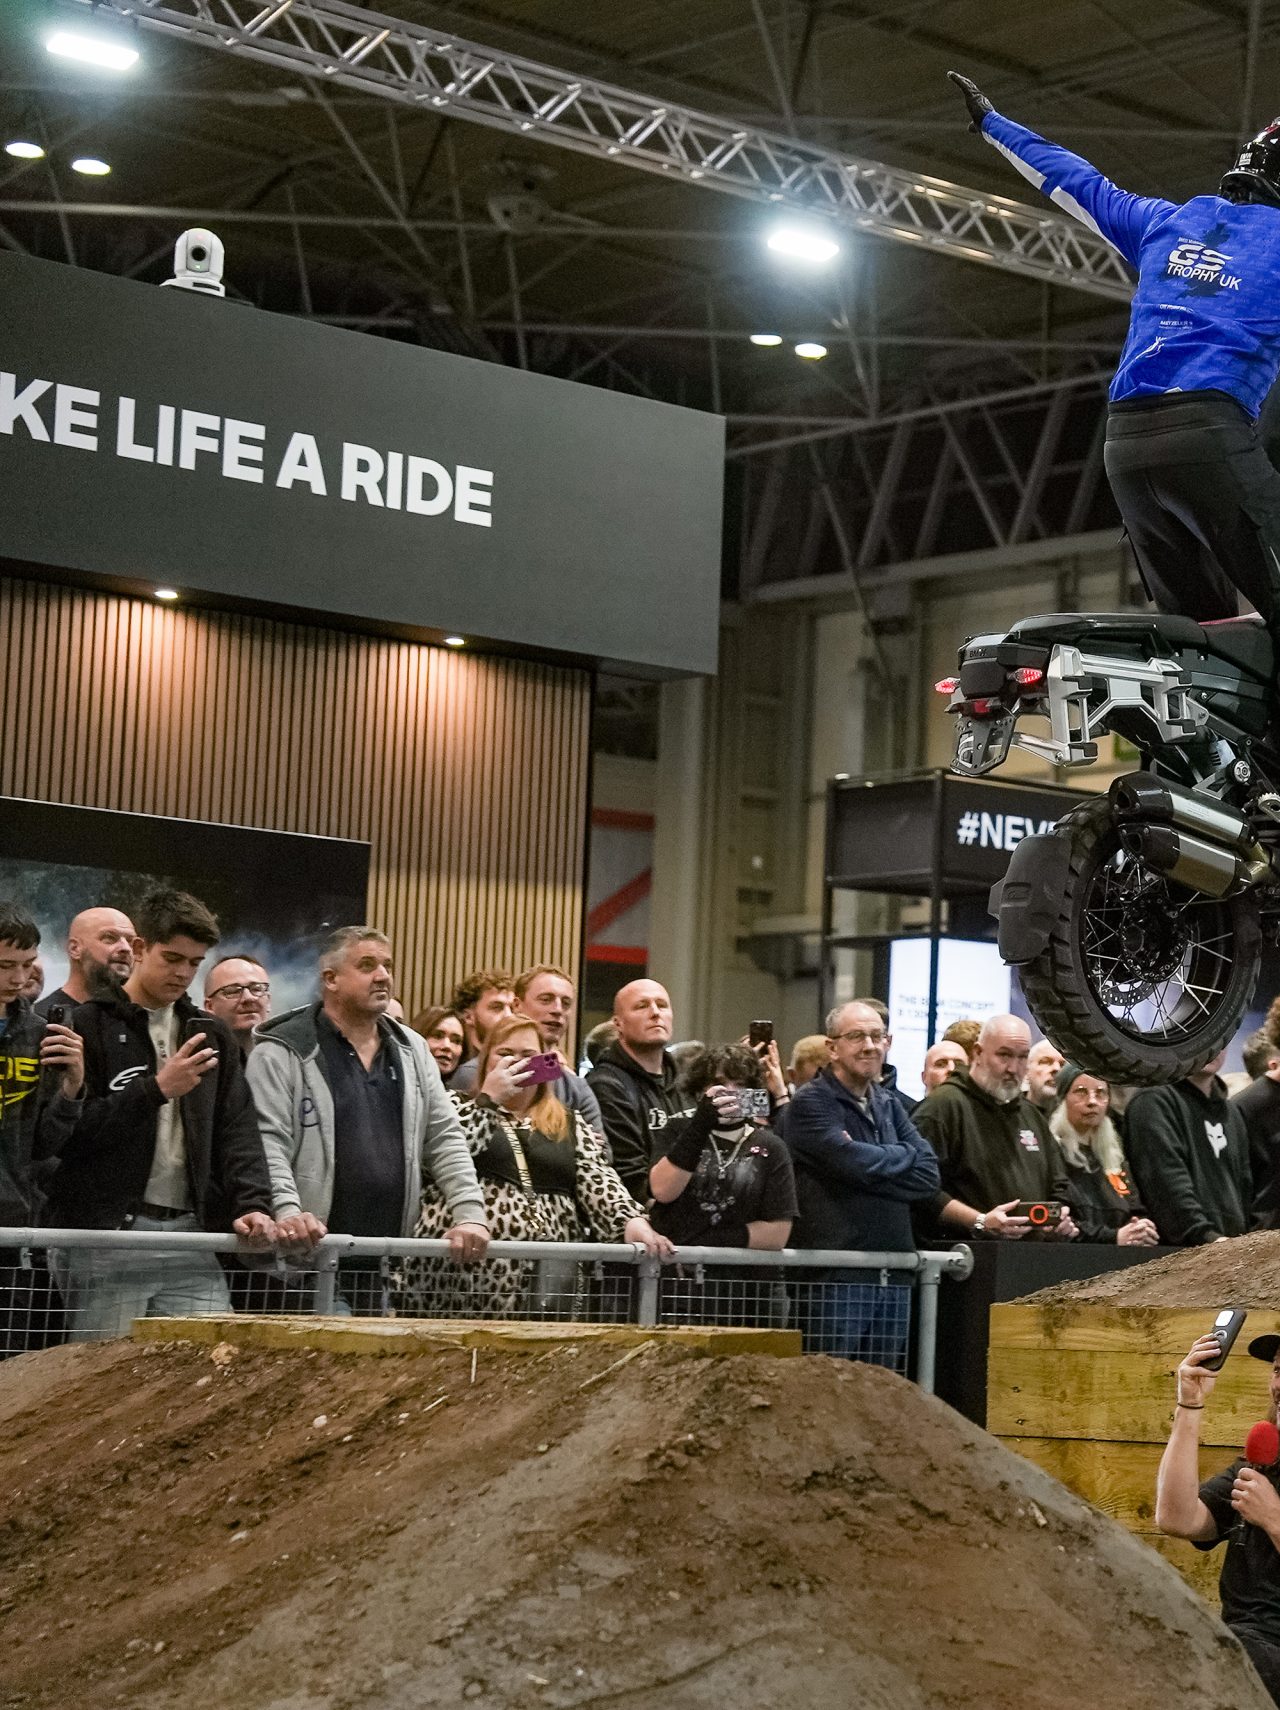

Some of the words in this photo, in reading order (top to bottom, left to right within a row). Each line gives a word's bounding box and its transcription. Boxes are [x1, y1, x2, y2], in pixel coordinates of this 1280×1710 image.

[1169, 244, 1233, 271] GS
[1167, 262, 1219, 283] TROPHY
[1219, 274, 1242, 290] UK
[116, 396, 266, 484] LIFE
[276, 432, 327, 496] A
[341, 442, 494, 527] RIDE
